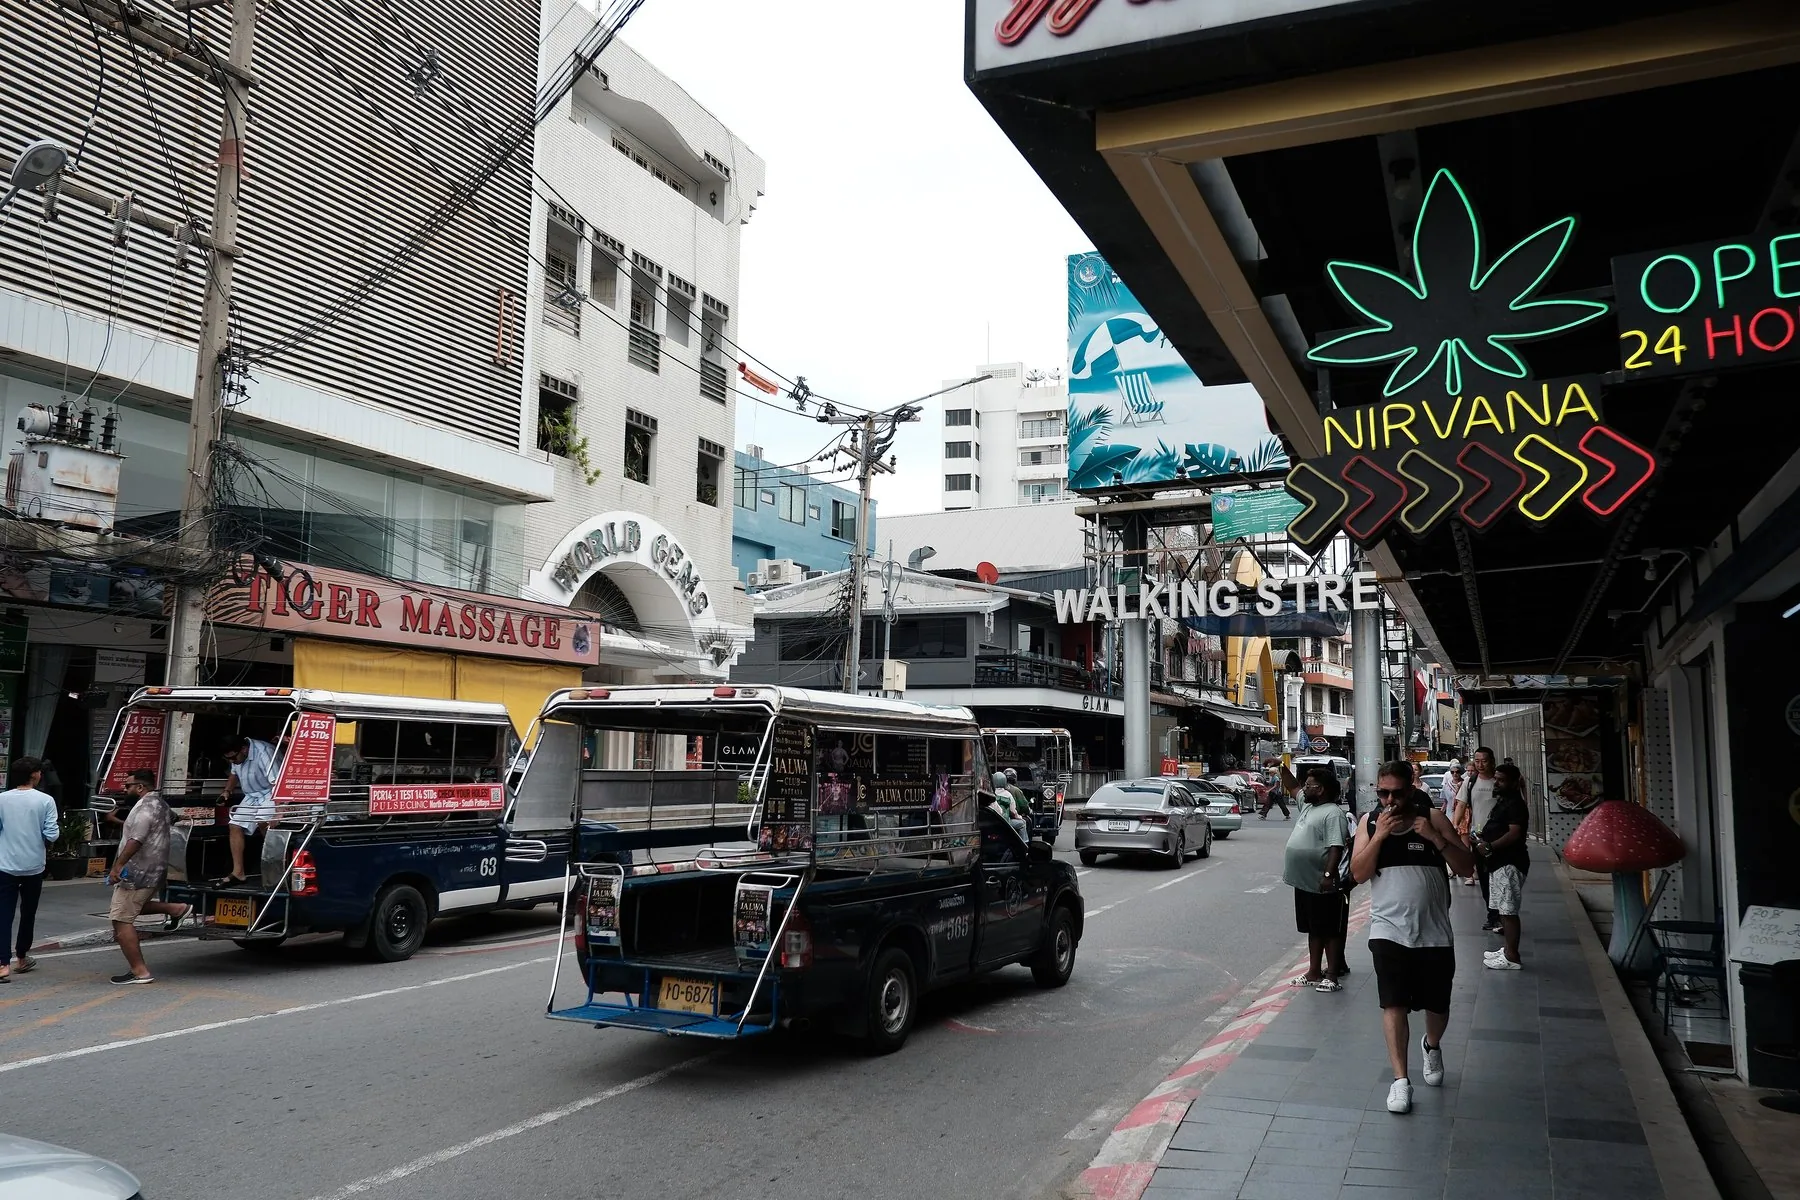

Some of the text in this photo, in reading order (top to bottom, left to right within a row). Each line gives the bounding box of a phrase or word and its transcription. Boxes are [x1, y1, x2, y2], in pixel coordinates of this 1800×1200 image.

[1640, 233, 1800, 314] OPE
[1620, 307, 1800, 370] 24 HO
[1323, 383, 1600, 455] NIRVANA
[551, 520, 708, 616] WORLD GEMS
[1053, 571, 1380, 624] WALKING STRE
[241, 570, 561, 650] TIGER MASSAGE
[1082, 695, 1110, 712] GLAM
[132, 716, 162, 725] 1 TEST
[310, 720, 331, 729] TEST
[140, 726, 160, 735] STDs
[299, 730, 330, 739] 14 STDs
[722, 746, 756, 754] GLAM
[774, 757, 808, 775] JALWA
[784, 777, 801, 786] CLUB
[400, 790, 414, 799] TEST
[415, 790, 422, 799] 14
[424, 789, 437, 799] STDs
[438, 789, 455, 798] CHECK
[455, 789, 470, 798] YOUR
[875, 788, 926, 803] JALWA CLUB
[443, 800, 458, 809] Pattaya
[474, 799, 490, 808] Pattaya
[480, 857, 497, 876] 63
[219, 904, 249, 918] 10-646
[740, 903, 764, 912] JALWA
